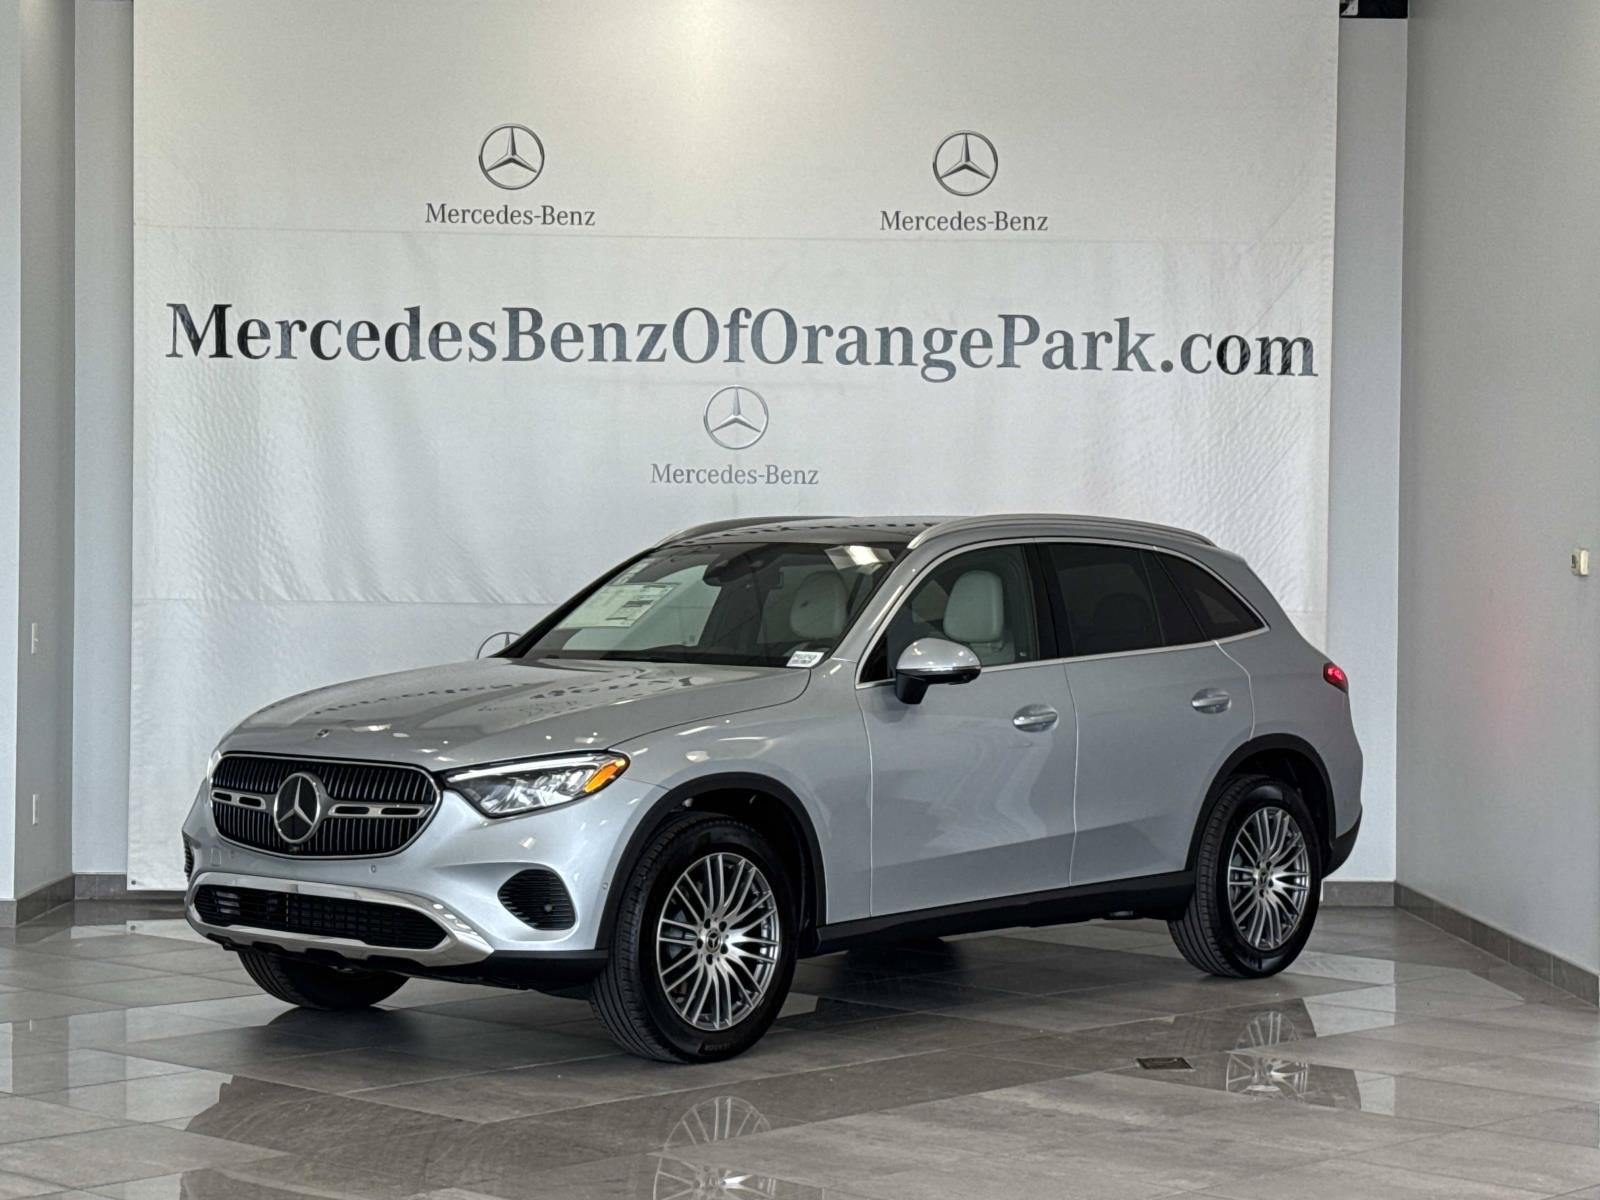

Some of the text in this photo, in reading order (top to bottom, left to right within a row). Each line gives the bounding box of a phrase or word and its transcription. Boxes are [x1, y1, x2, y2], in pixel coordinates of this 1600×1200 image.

[425, 203, 595, 226] Mercedes-Benz
[881, 210, 1048, 231] Mercedes-Benz
[166, 303, 1319, 382] MercedesBenzOfOrangePark.com
[652, 464, 819, 485] Mercedes-Benz
